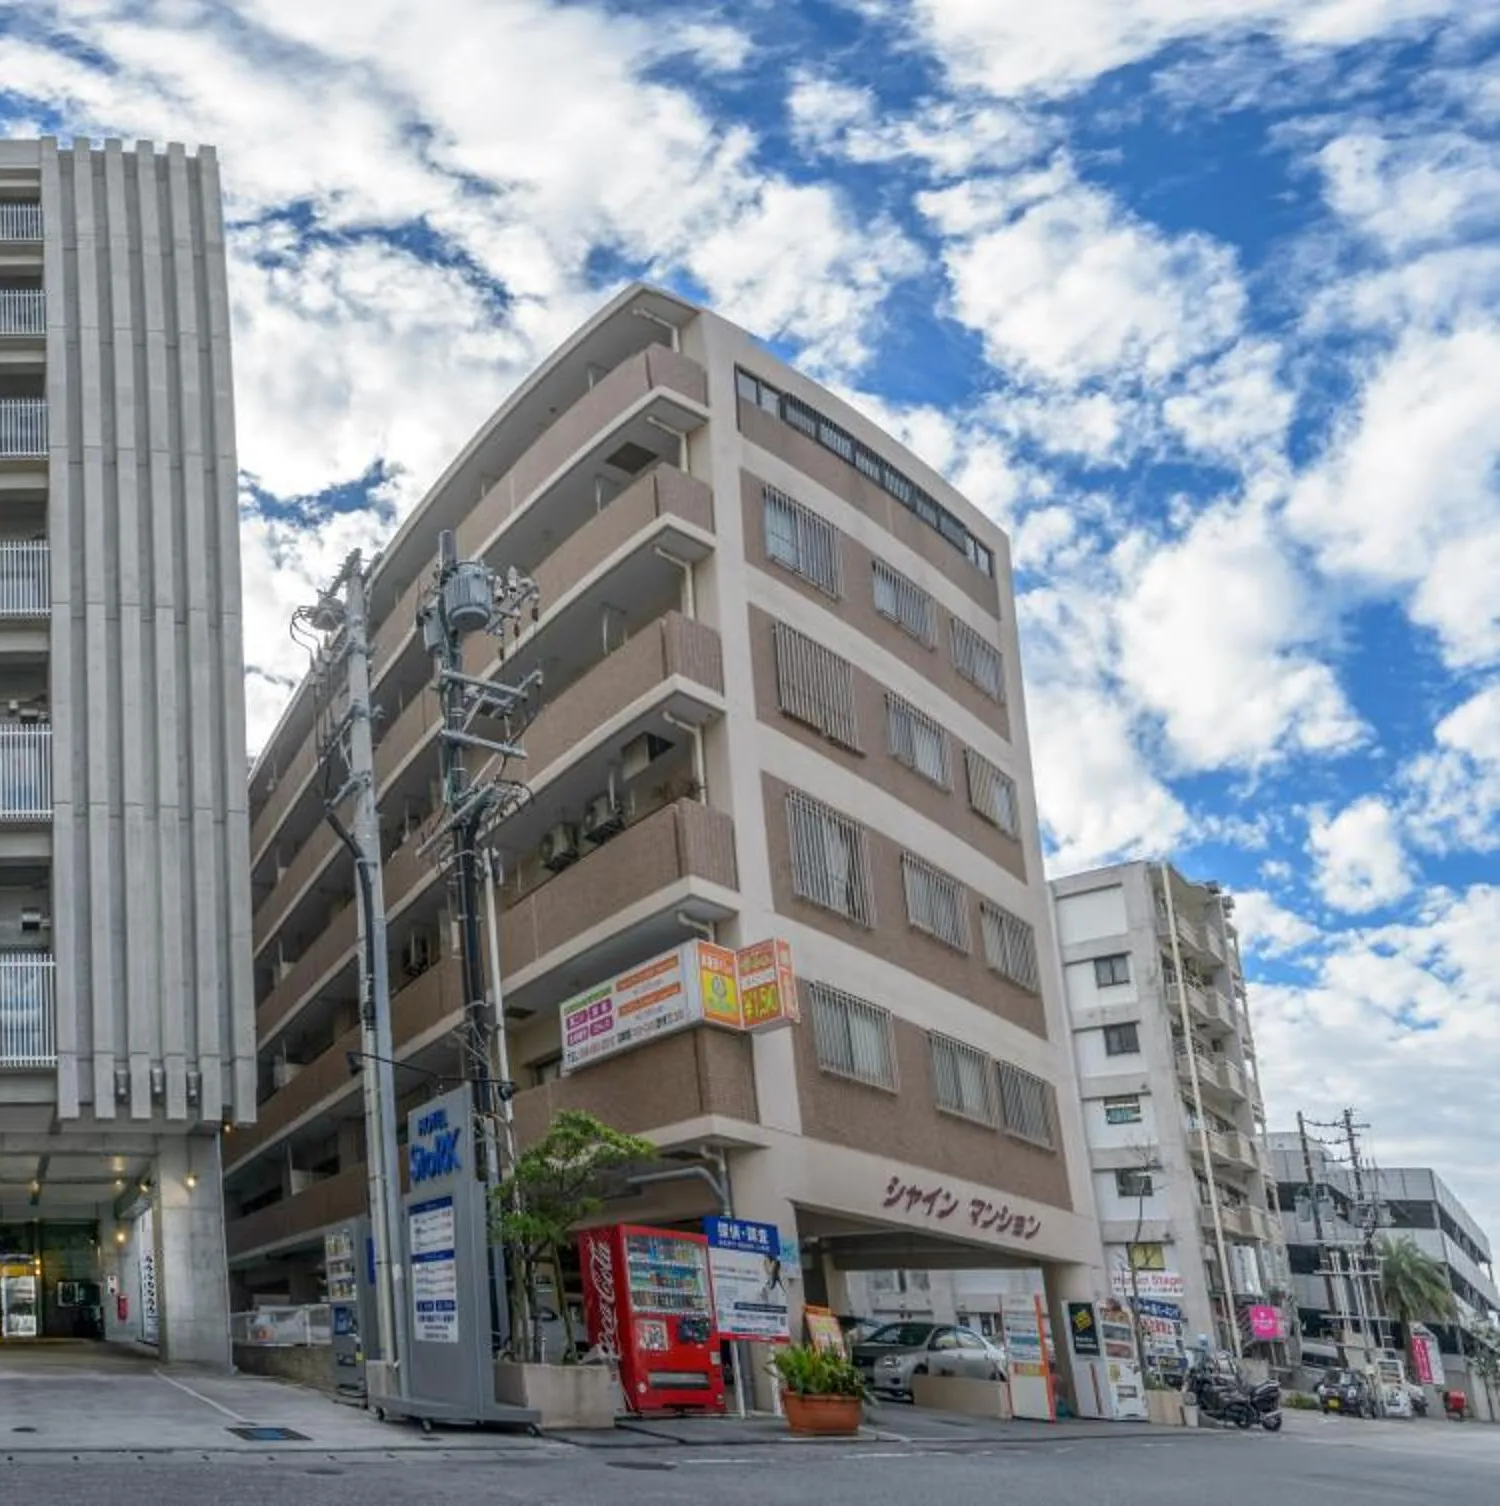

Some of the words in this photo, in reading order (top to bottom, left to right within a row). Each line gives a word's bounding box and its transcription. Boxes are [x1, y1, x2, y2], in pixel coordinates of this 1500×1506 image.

[883, 1175, 959, 1220] シャイン
[970, 1198, 1042, 1241] マンション
